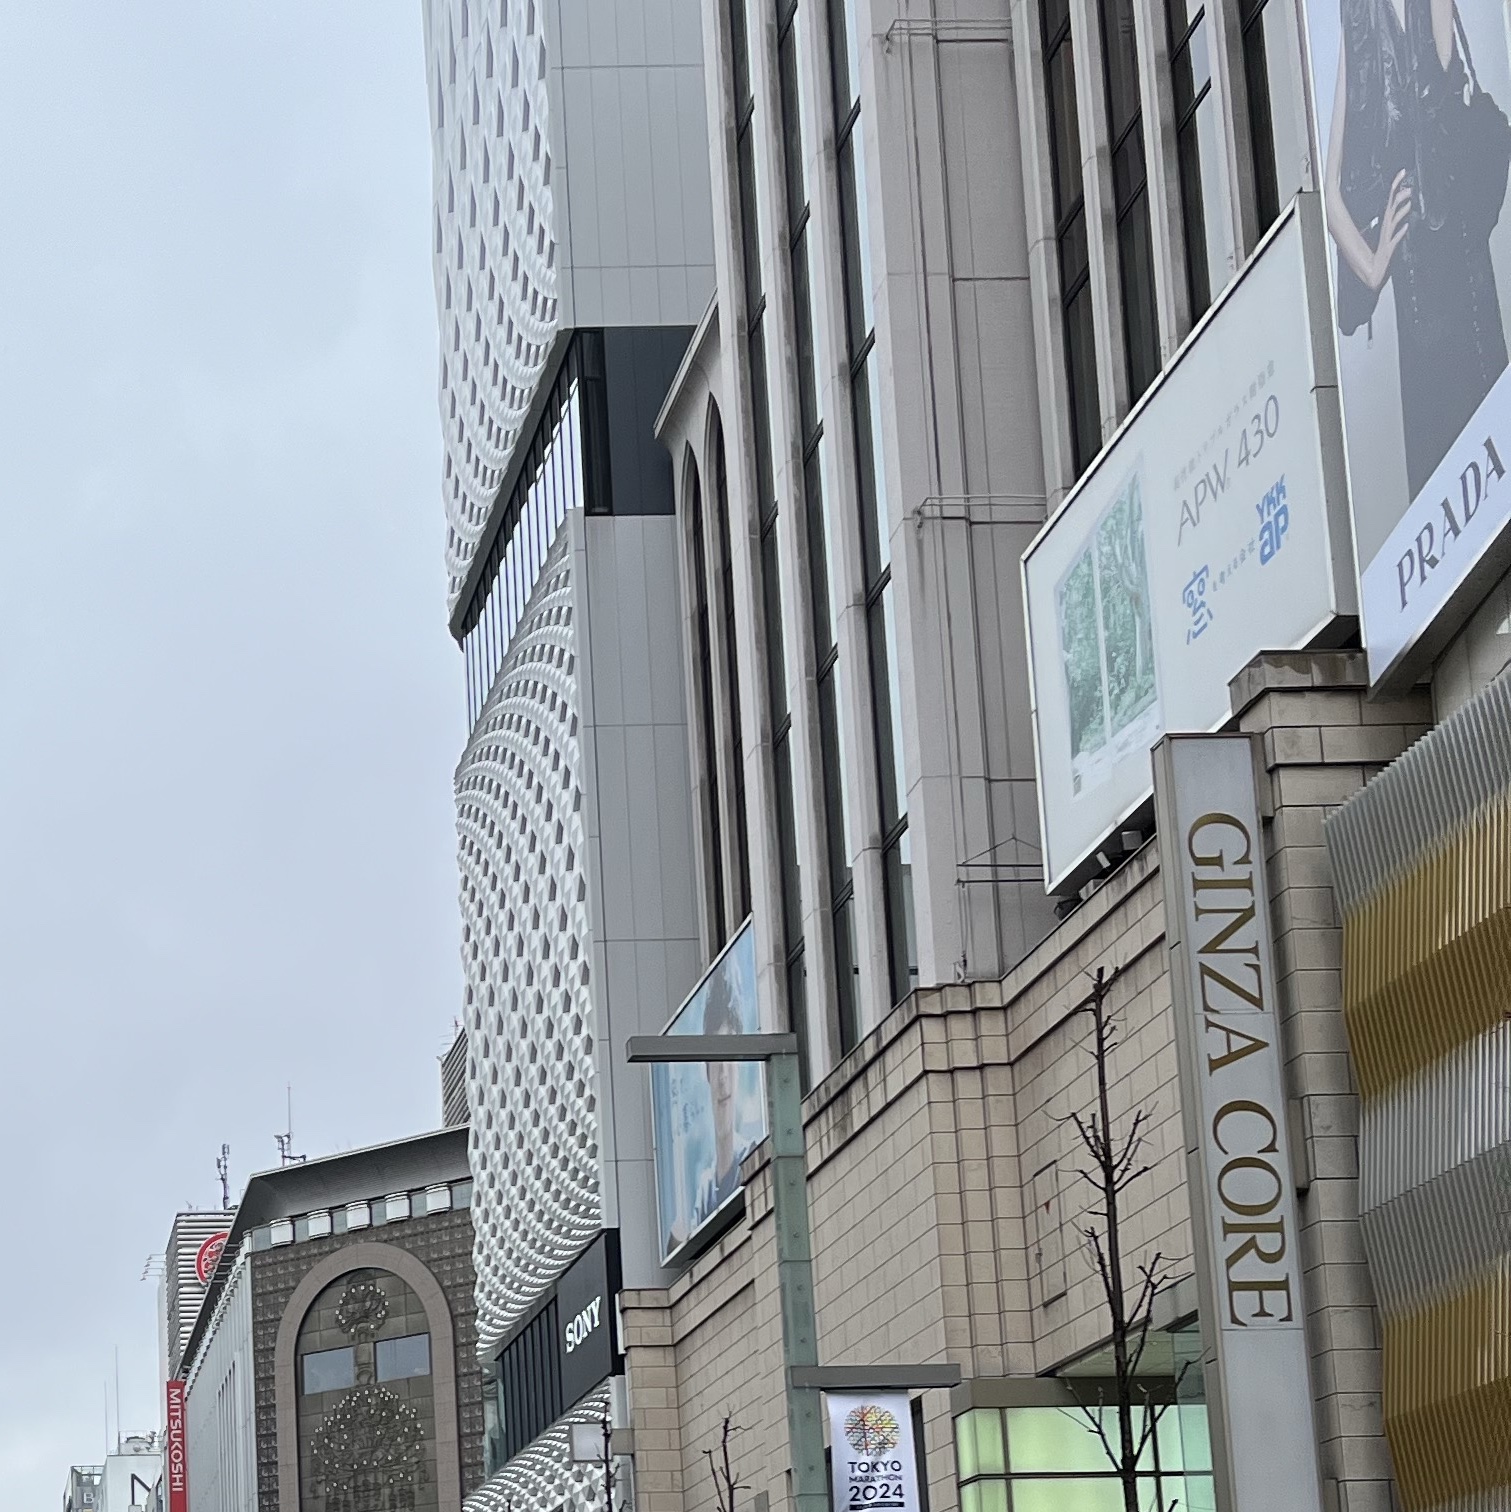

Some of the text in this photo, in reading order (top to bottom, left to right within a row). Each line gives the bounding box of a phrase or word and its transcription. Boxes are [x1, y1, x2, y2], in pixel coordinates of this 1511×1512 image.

[1177, 394, 1279, 547] APW 430
[1255, 473, 1287, 525] YKK
[1397, 435, 1505, 613] PRADA
[1187, 812, 1292, 1326] GINZA CORE
[564, 1296, 602, 1355] SONY
[169, 1388, 184, 1493] MITSUKOSHI
[848, 1460, 902, 1474] TOKYO
[849, 1473, 903, 1484] MARATHON
[849, 1483, 905, 1502] 2024
